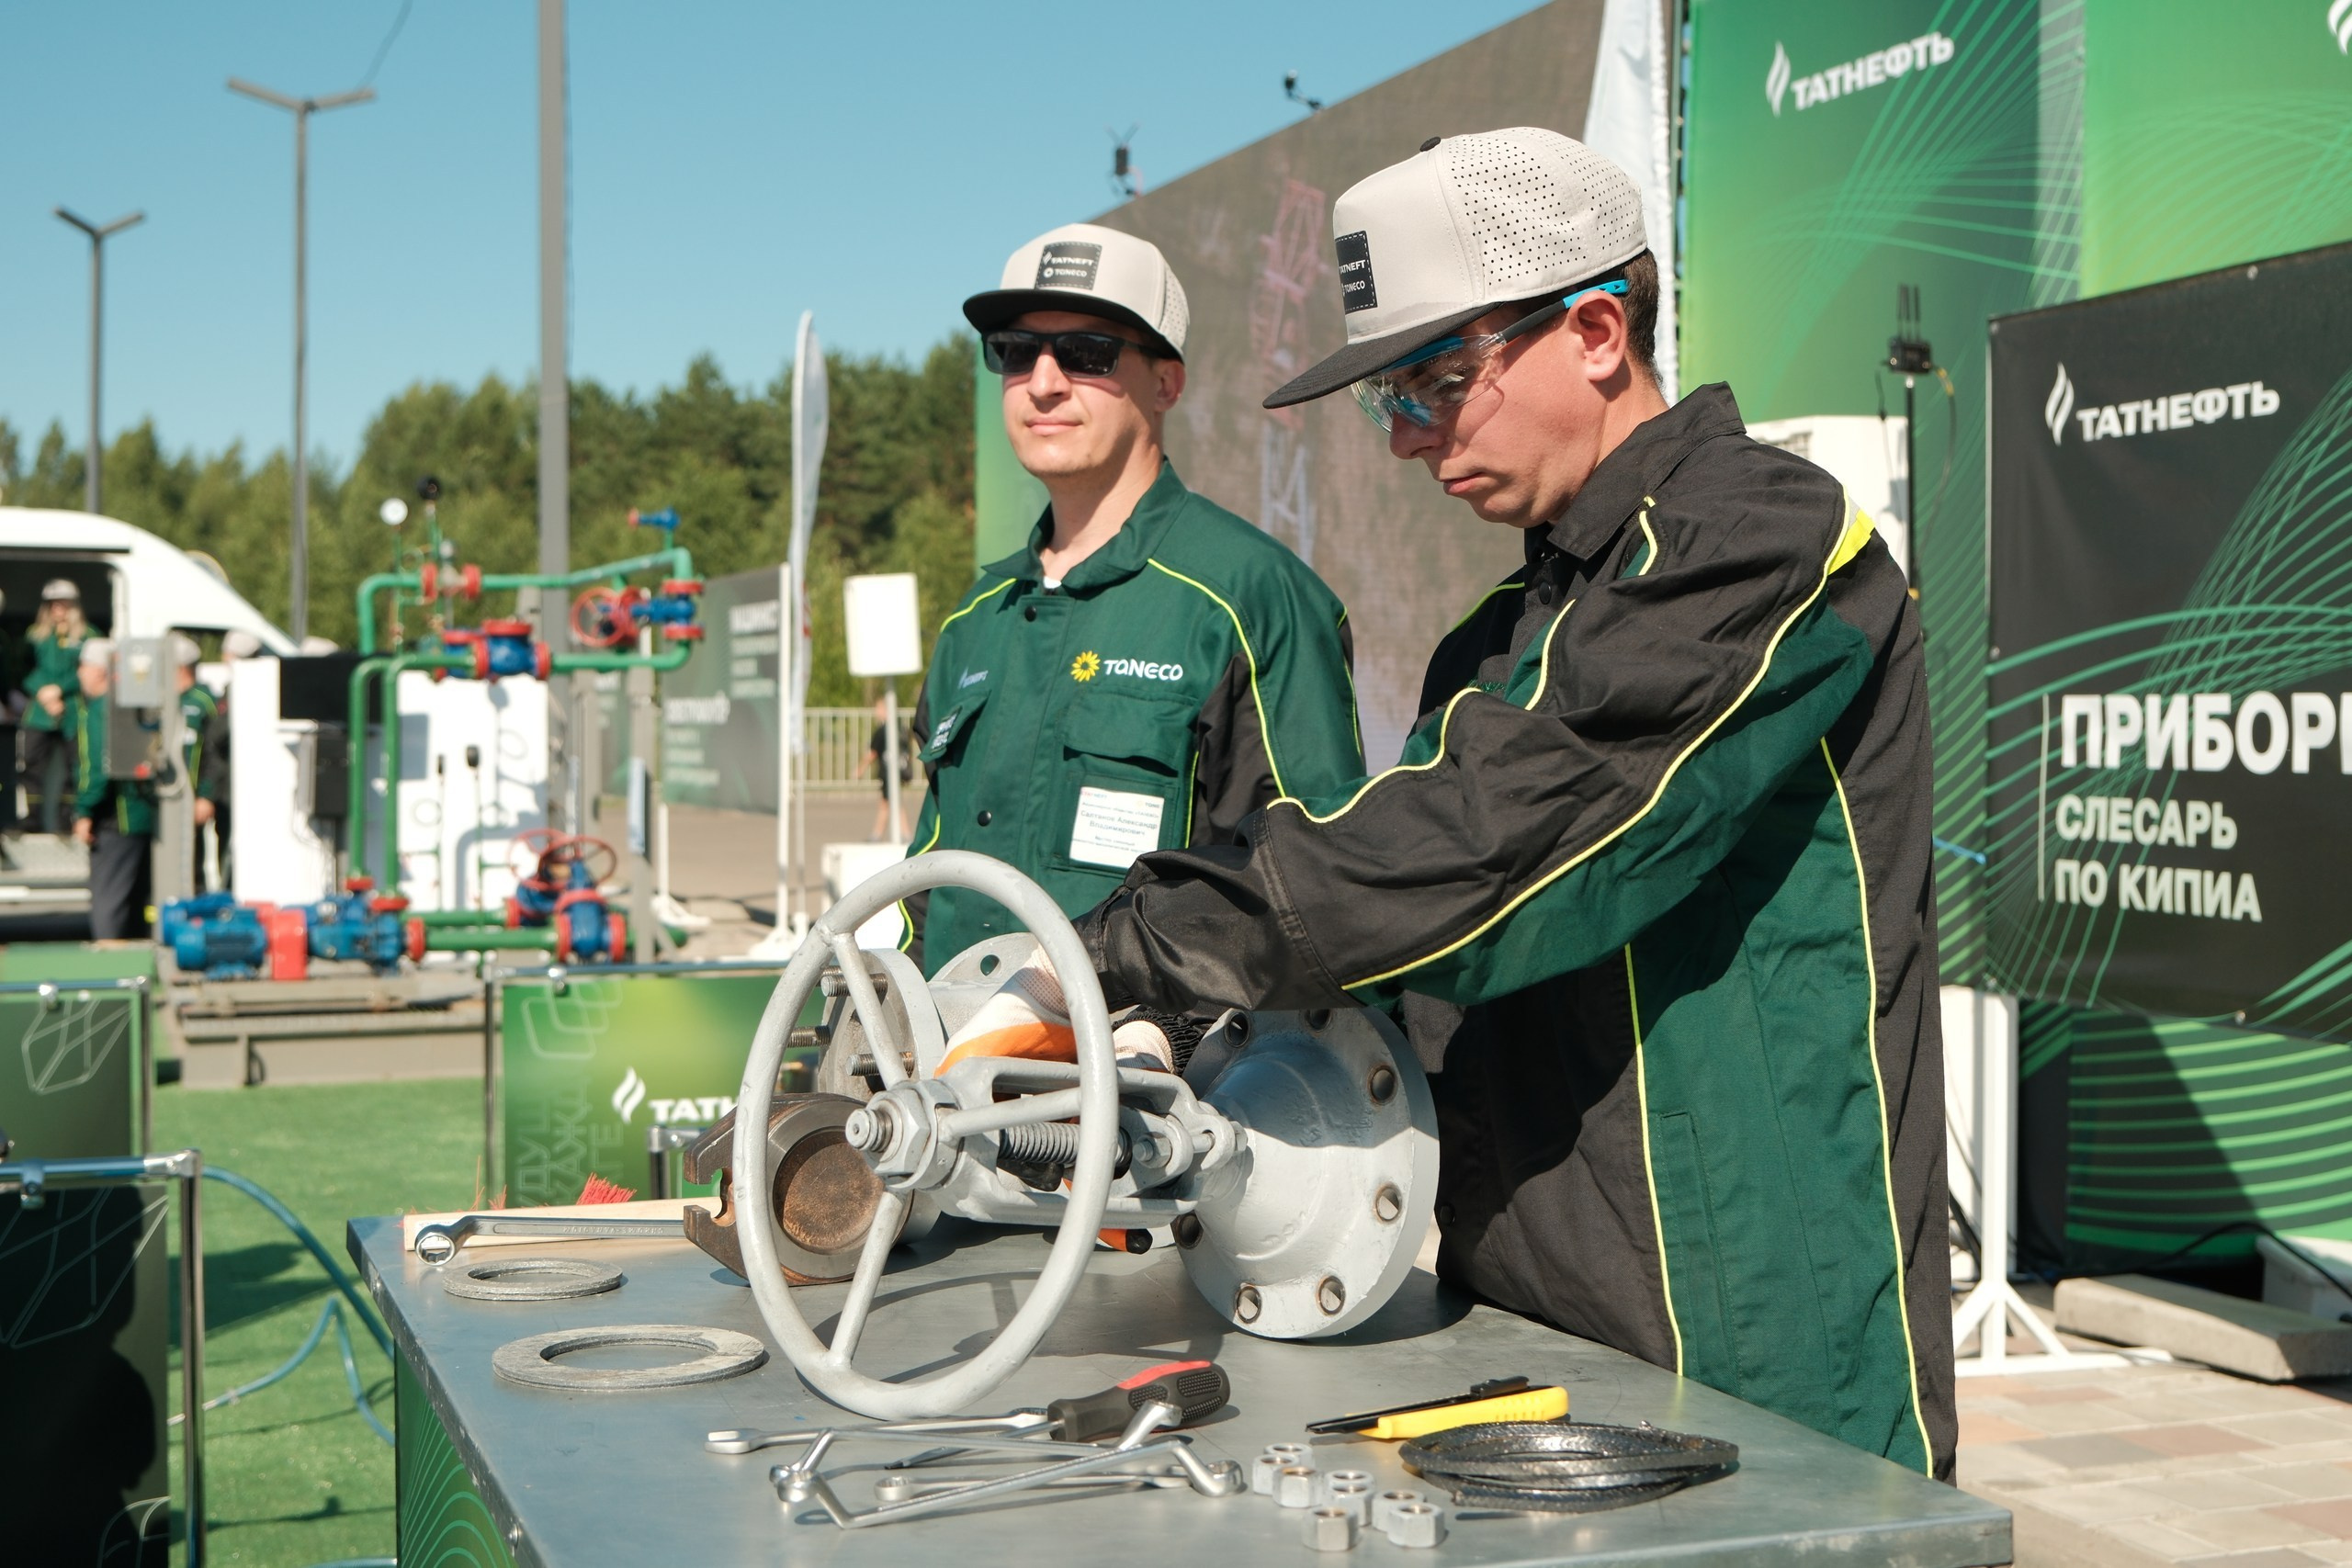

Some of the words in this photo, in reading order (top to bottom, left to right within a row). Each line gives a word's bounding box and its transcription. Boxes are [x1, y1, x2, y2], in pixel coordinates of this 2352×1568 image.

[1790, 31, 1955, 110] ТАТНЕФТЬ
[1051, 257, 1094, 266] TATNEFT
[2076, 381, 2280, 442] ТАТНЕФТЬ
[1103, 658, 1184, 682] TANECO
[2061, 690, 2352, 775] ПРИБОР
[2055, 794, 2238, 850] СЛЕСАРЬ
[2054, 858, 2108, 907] ПО
[2119, 863, 2262, 922] КИПИА
